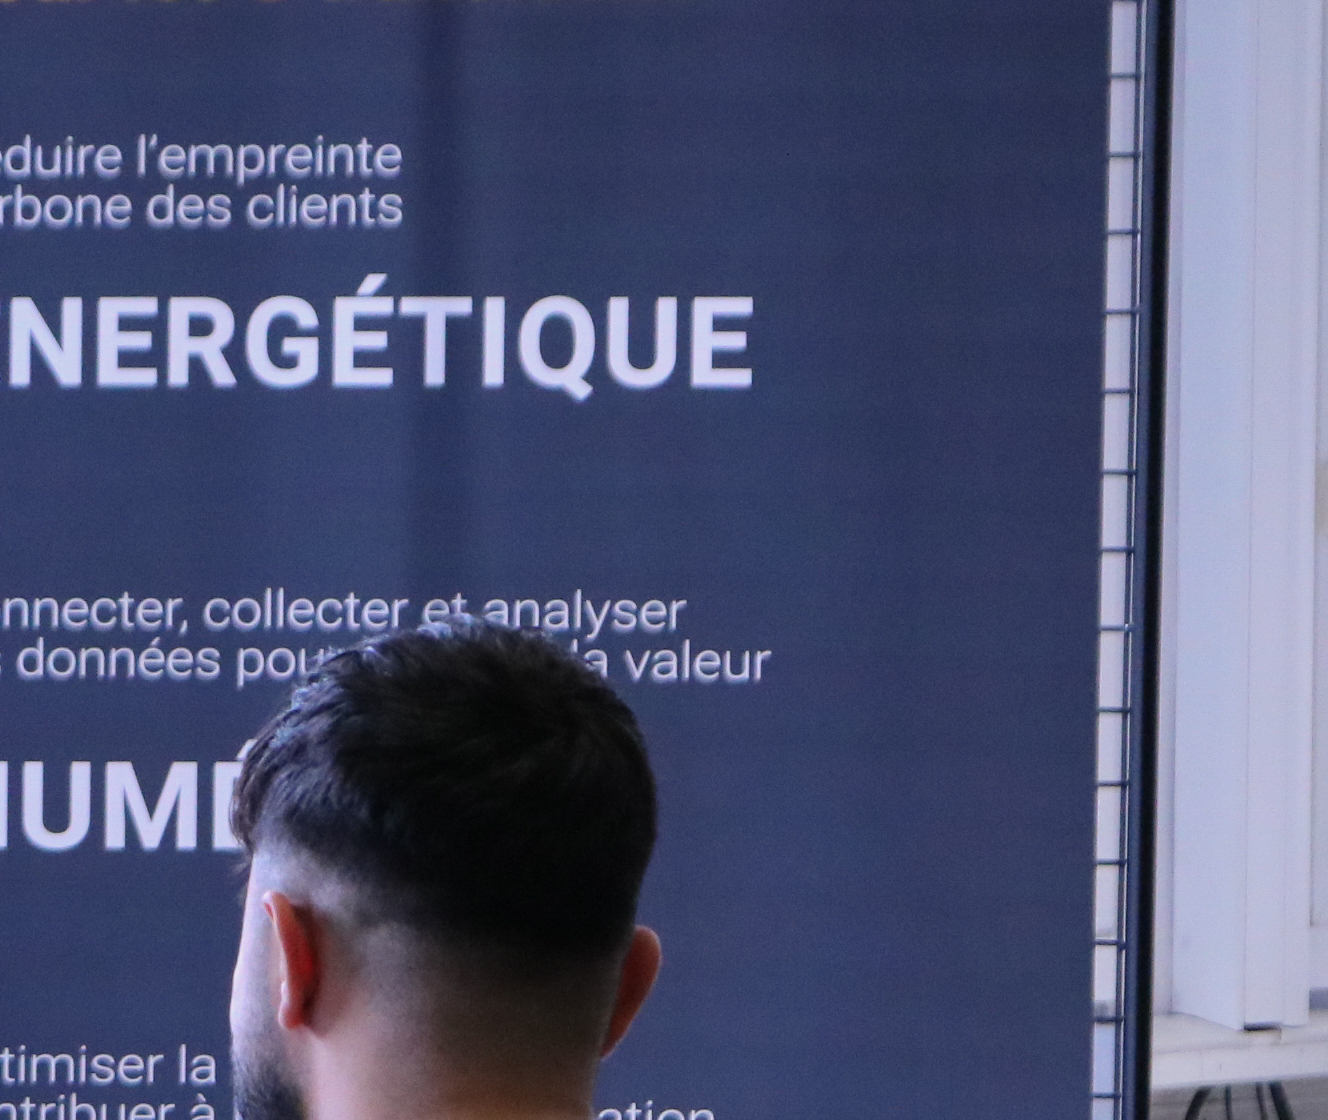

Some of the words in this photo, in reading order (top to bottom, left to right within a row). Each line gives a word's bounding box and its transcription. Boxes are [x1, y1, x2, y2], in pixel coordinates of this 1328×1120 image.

[146, 185, 234, 229] des
[246, 185, 405, 229] clients
[203, 587, 411, 632] collecter
[422, 590, 470, 631] et
[480, 588, 687, 640] analyser
[16, 637, 223, 682] données
[236, 646, 328, 690] pou
[623, 639, 774, 684] valeur
[178, 1043, 218, 1085] la
